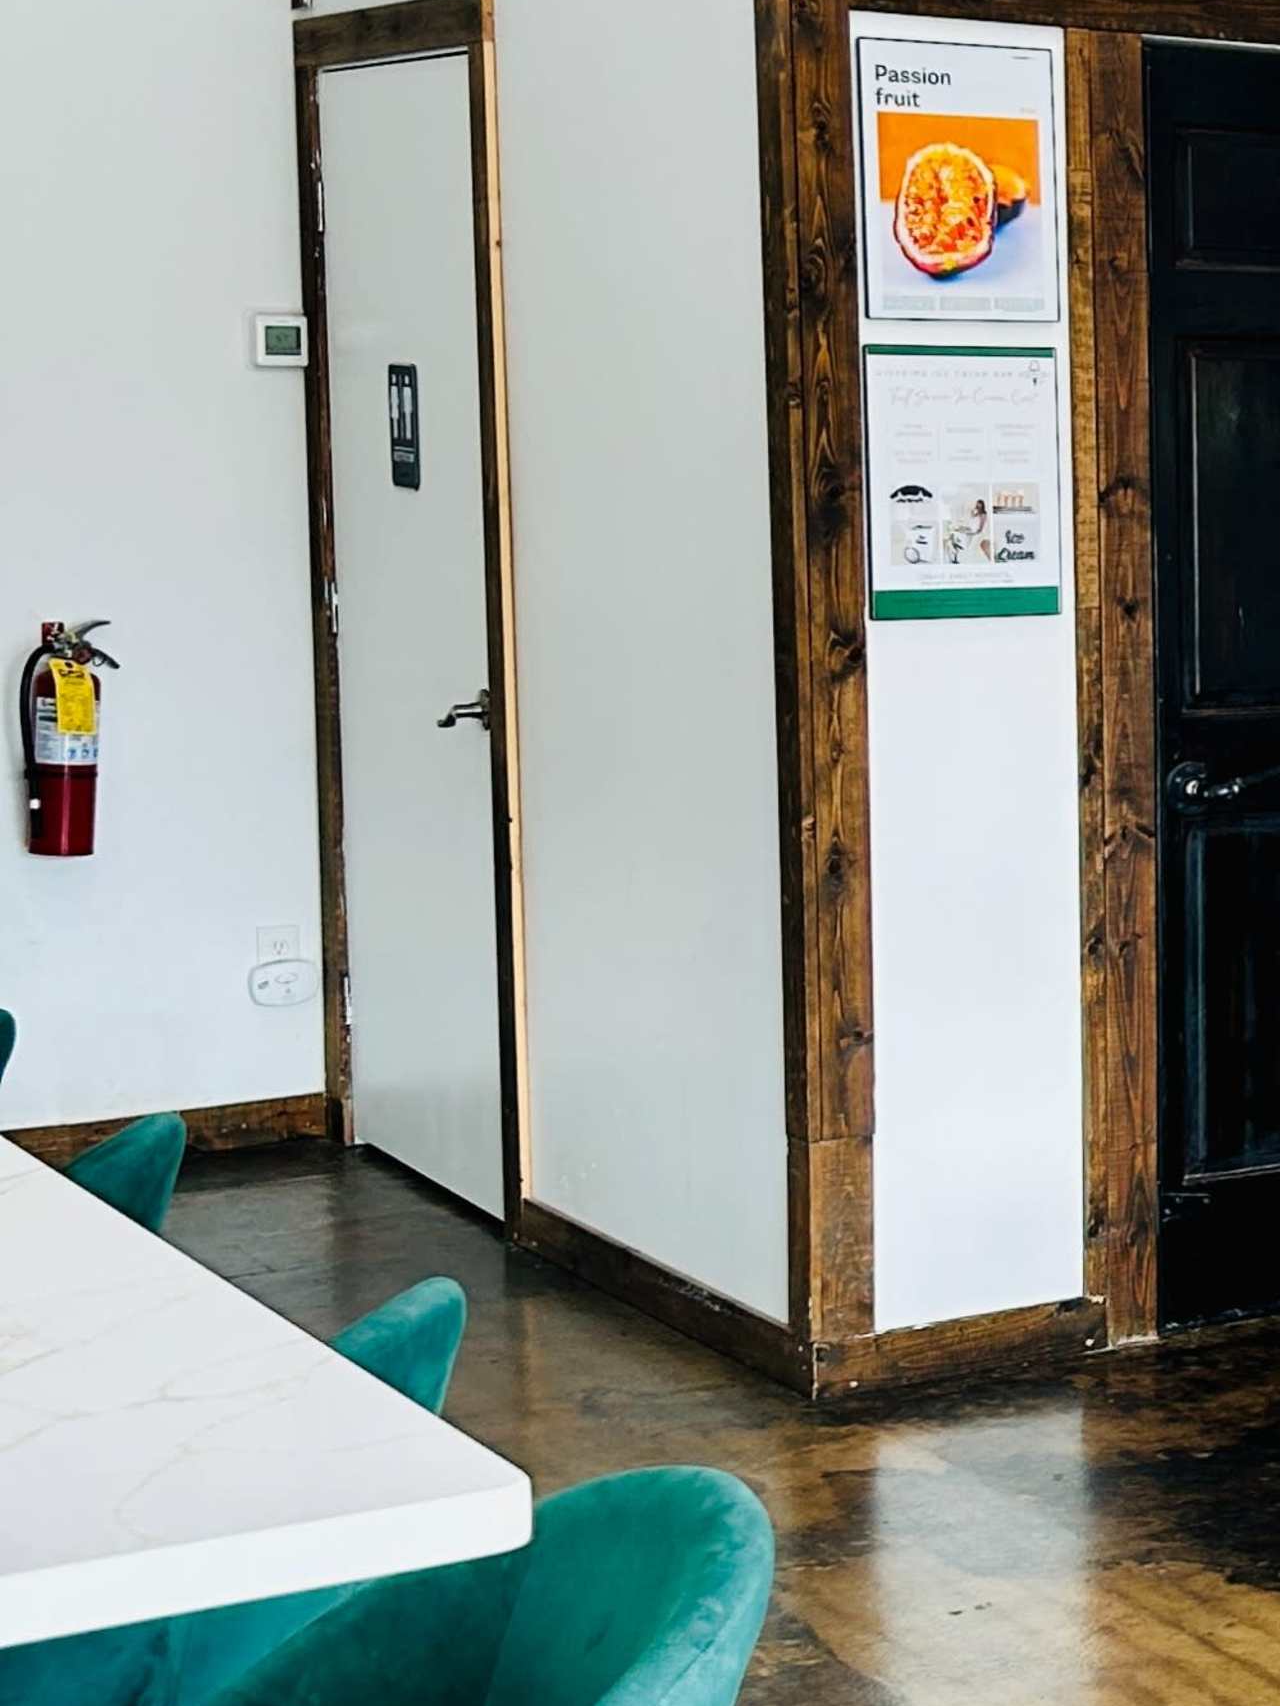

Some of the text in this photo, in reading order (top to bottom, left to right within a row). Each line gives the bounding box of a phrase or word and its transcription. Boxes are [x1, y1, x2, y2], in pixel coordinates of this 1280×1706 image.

[875, 64, 951, 85] Passion
[875, 87, 920, 108] fruit
[1005, 529, 1025, 544] Ice
